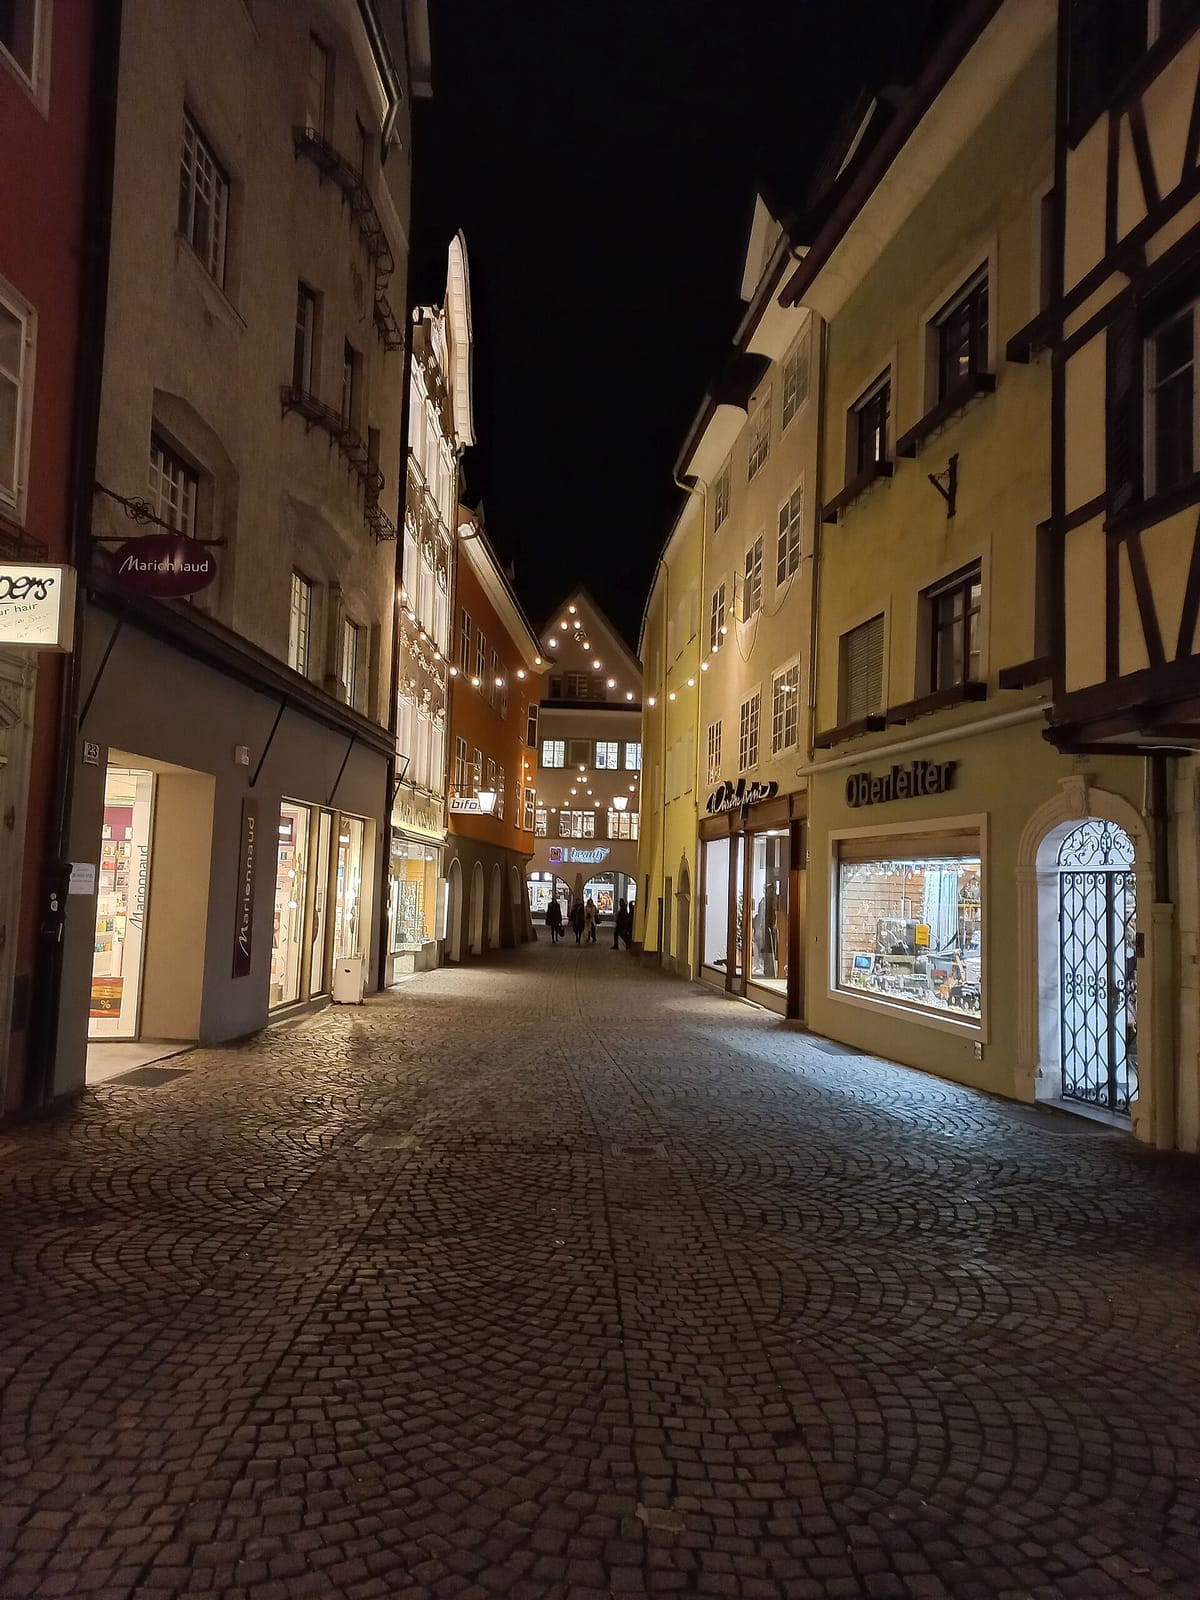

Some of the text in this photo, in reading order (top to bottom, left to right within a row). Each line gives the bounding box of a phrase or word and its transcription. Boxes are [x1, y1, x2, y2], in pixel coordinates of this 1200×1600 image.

[14, 603, 38, 613] hair
[87, 743, 98, 758] 23
[847, 761, 954, 807] Oberleiter
[129, 845, 149, 931] Marionnaud
[238, 816, 255, 957] Marionnaud
